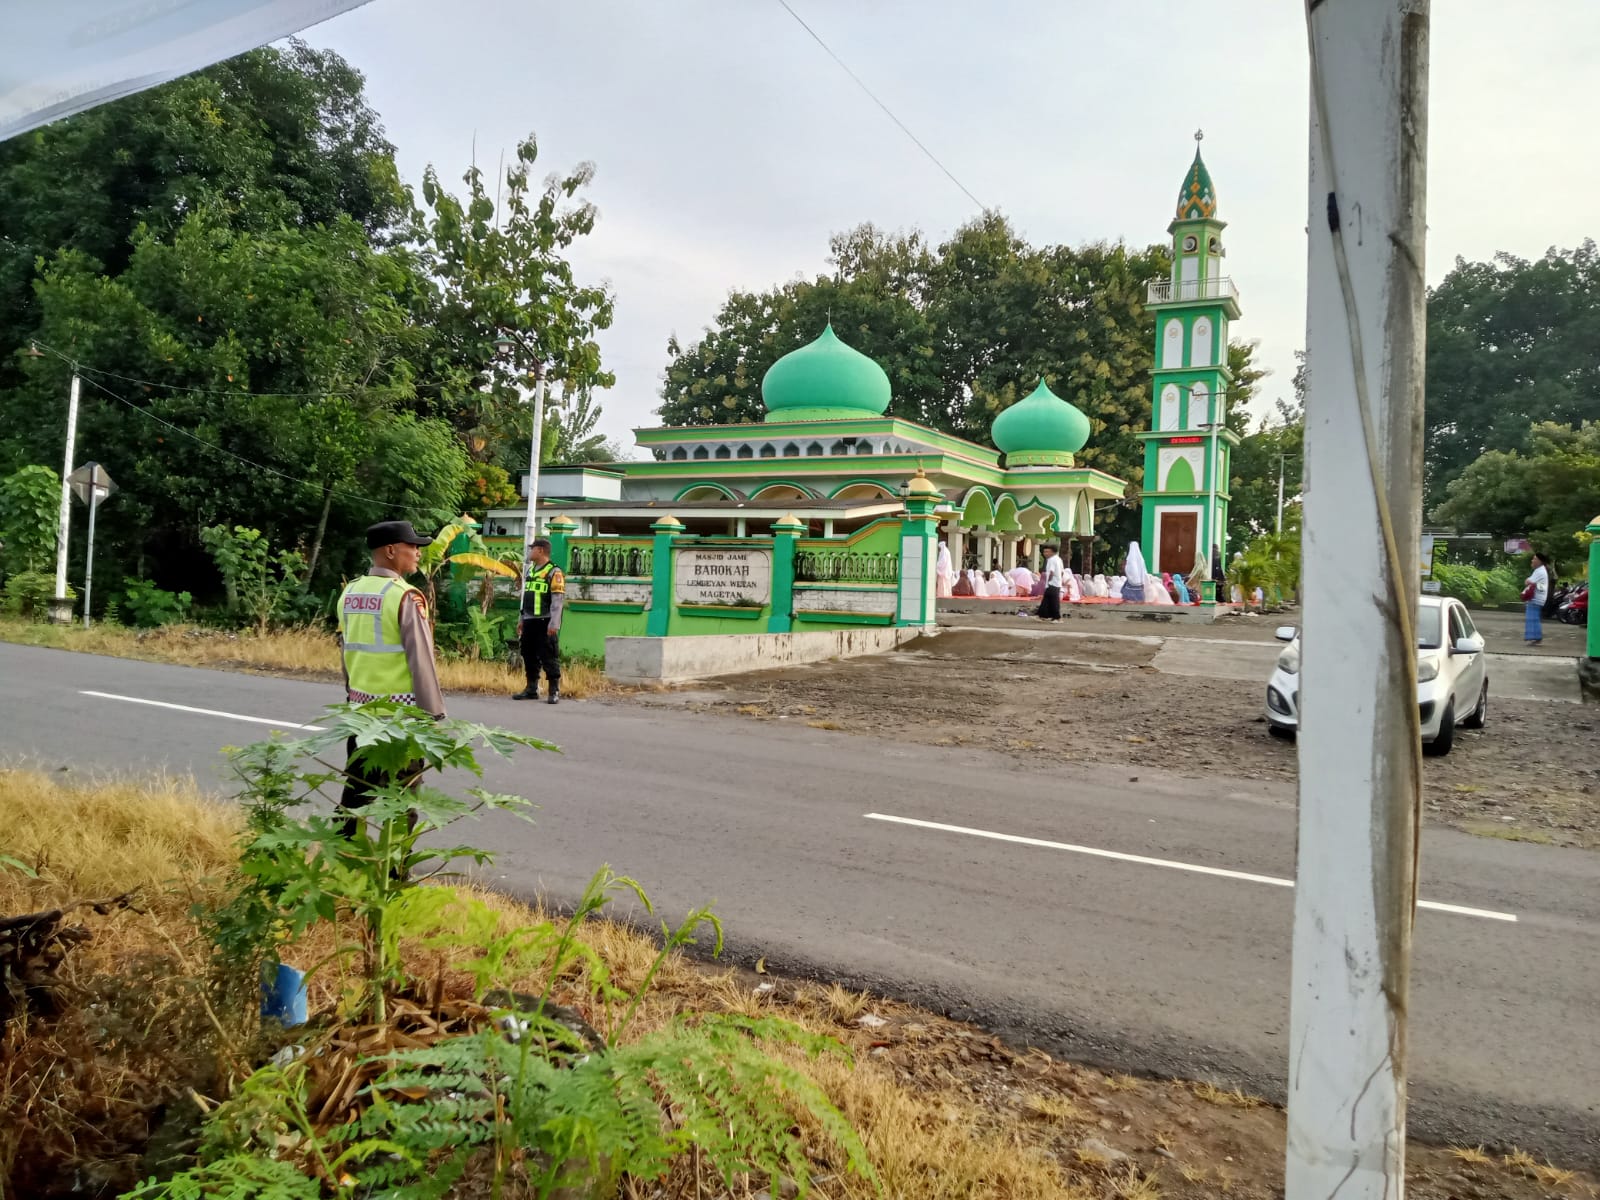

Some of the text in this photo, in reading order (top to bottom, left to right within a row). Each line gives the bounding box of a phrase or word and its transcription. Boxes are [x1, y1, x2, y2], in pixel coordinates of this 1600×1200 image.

[686, 579, 726, 588] LEMBEYAN
[699, 590, 743, 599] MAGETAN
[343, 596, 382, 610] POLISI
